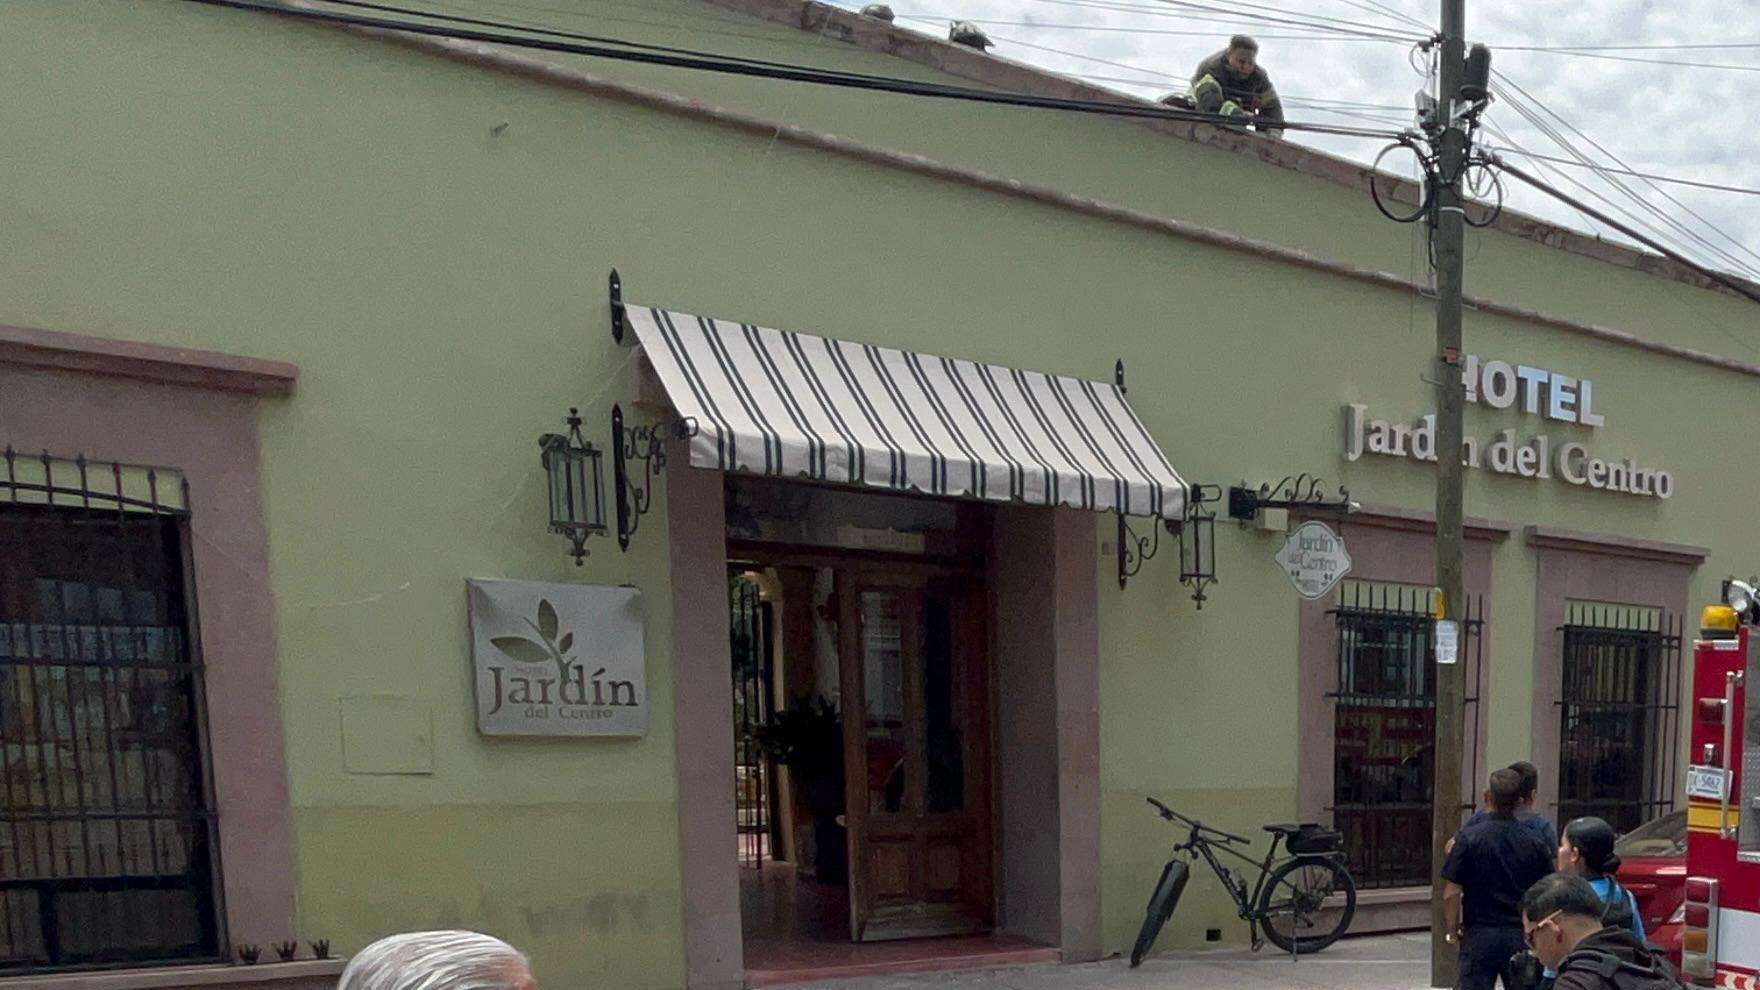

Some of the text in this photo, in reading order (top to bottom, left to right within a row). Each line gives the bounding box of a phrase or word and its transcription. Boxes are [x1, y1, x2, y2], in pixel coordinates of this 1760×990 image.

[1347, 402, 1674, 500] Jardn del Centro
[487, 664, 639, 716] Jardín
[524, 703, 613, 720] del Centro
